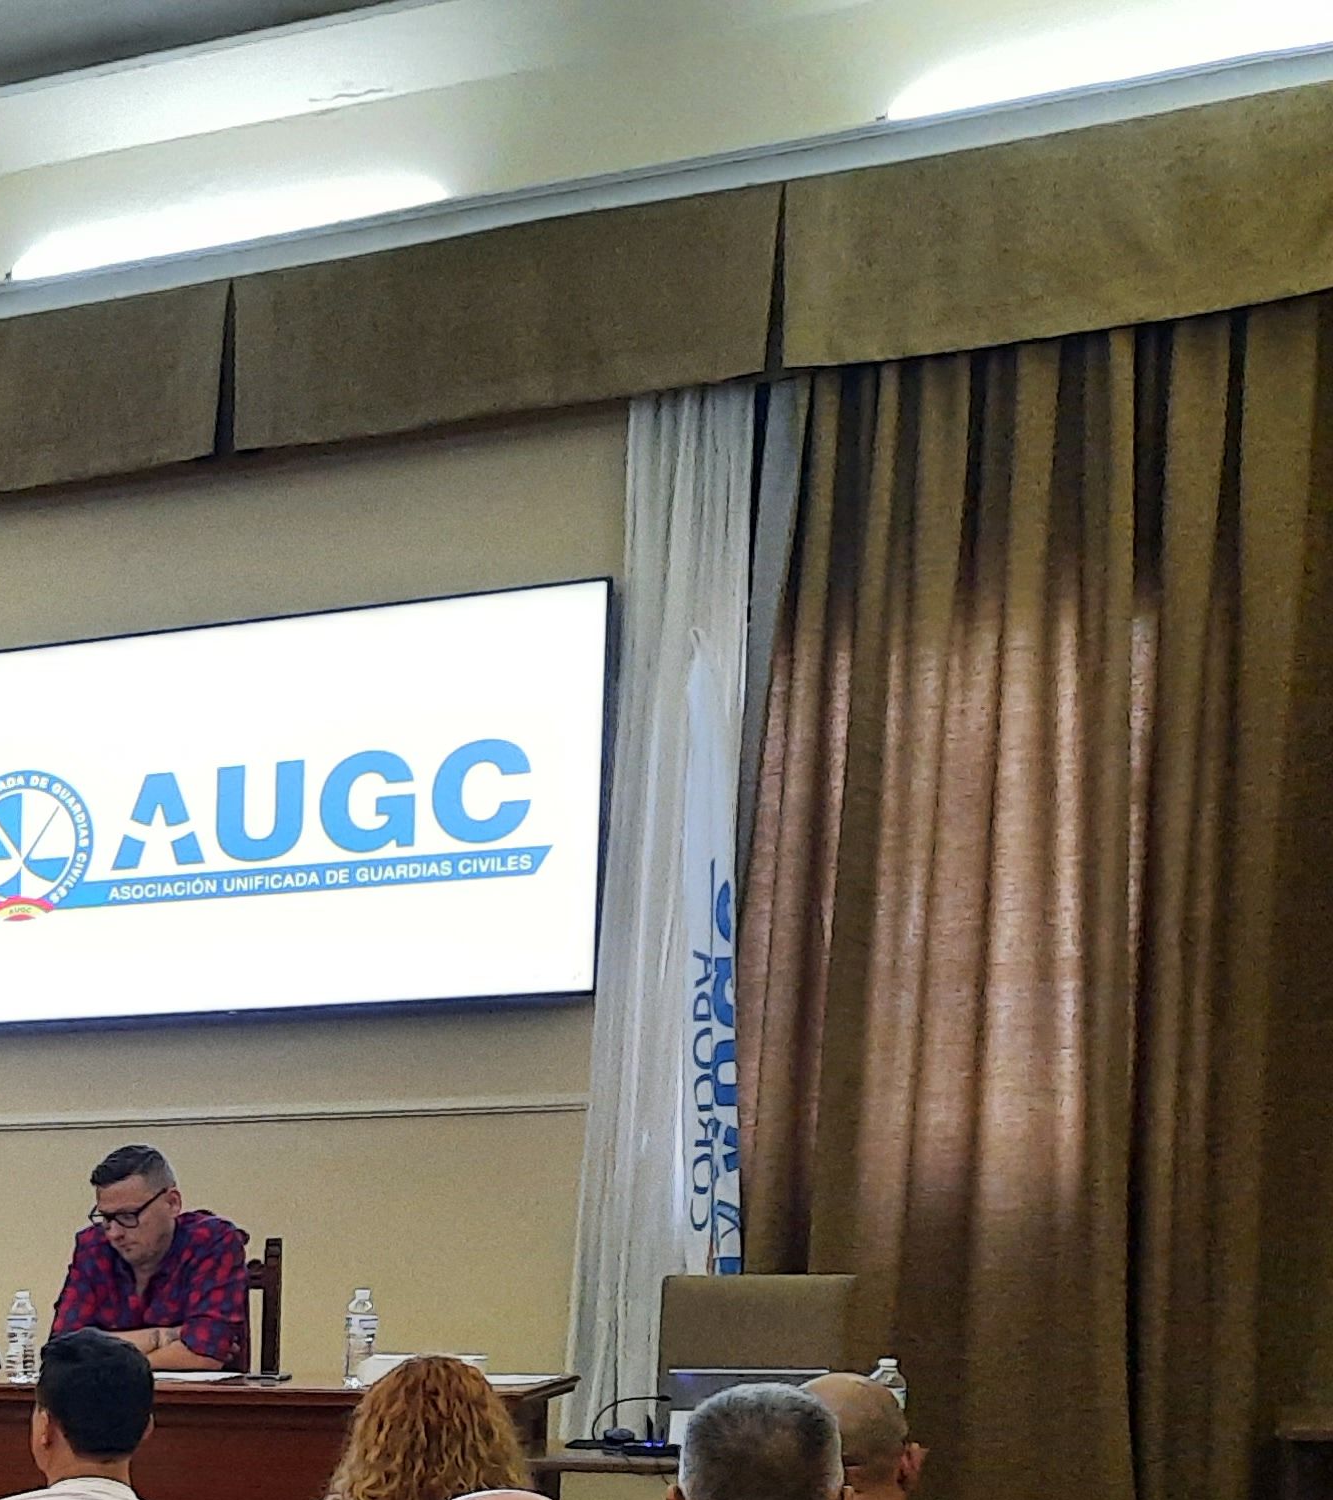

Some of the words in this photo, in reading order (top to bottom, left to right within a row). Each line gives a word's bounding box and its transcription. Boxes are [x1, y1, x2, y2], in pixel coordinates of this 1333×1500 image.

[111, 739, 532, 870] AUGC
[109, 876, 217, 900] ASOCIACIÓN
[223, 871, 320, 893] UNIFICADA
[325, 869, 350, 885] DE
[356, 861, 452, 883] GUARDIAS
[458, 854, 532, 875] CIVILES
